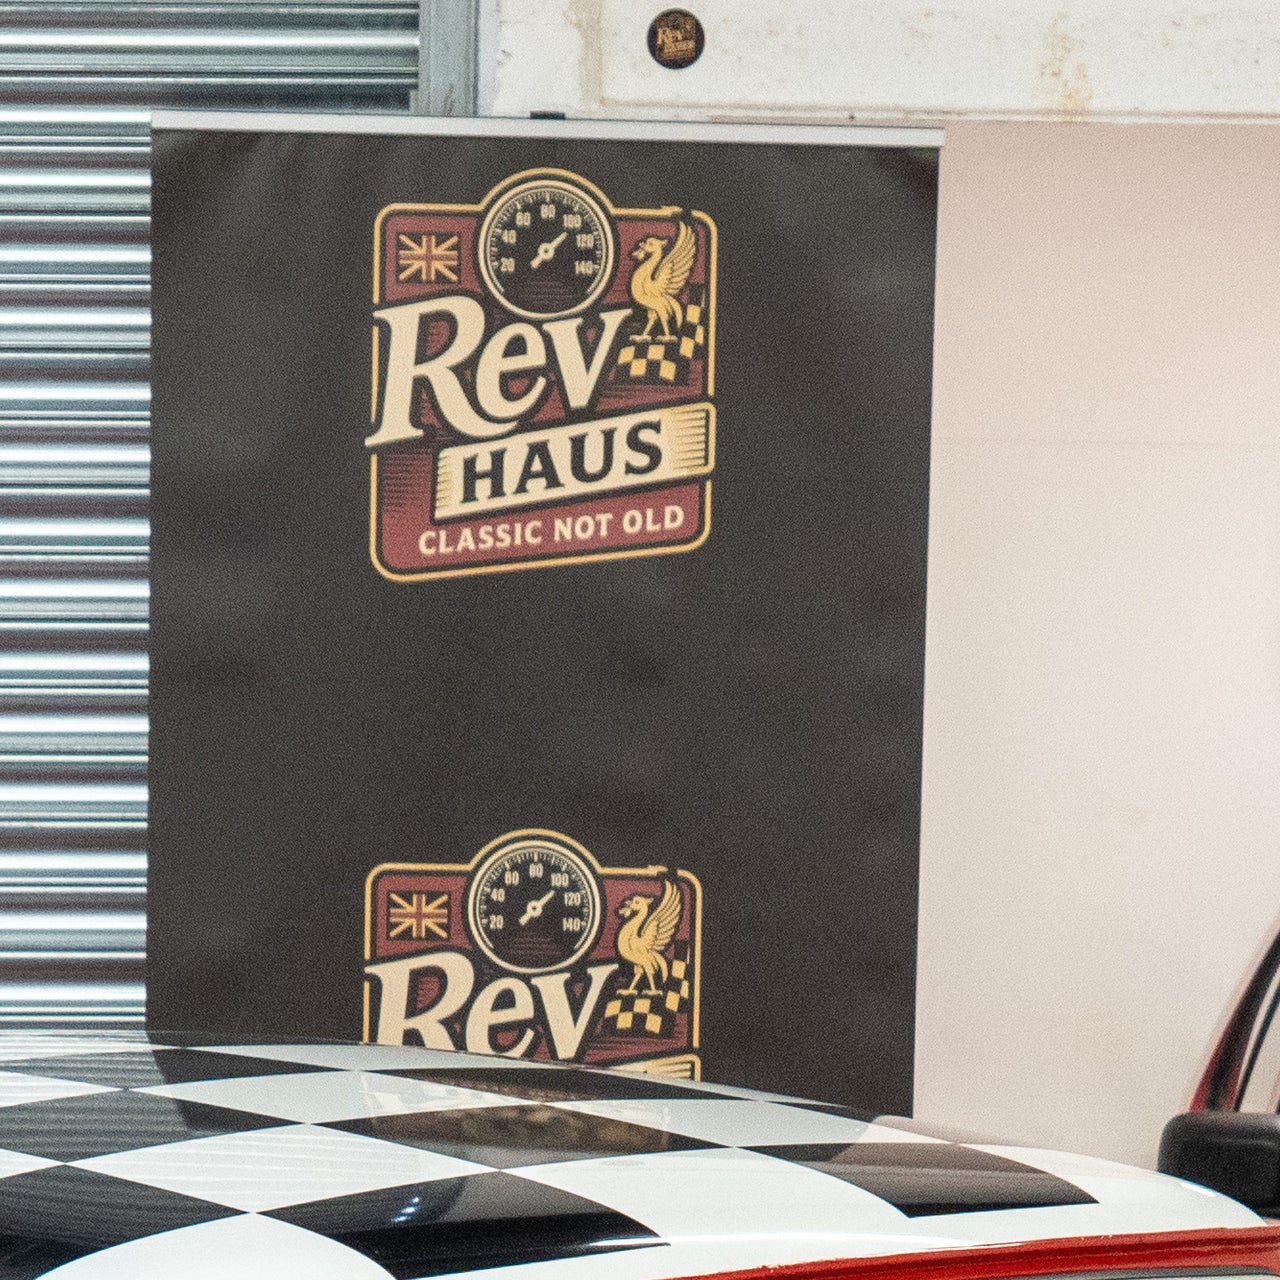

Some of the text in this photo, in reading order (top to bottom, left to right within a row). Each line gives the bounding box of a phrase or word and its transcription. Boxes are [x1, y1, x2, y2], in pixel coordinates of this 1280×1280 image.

[563, 213, 581, 228] 100
[502, 229, 517, 245] 40
[576, 233, 594, 248] 120
[500, 257, 515, 273] 20
[574, 260, 593, 275] 140
[365, 295, 632, 447] Rev
[460, 418, 663, 504] HAUS
[419, 505, 685, 555] CLASSIC NOT OLD
[529, 863, 544, 878] 80
[551, 873, 569, 888] 100
[491, 889, 506, 904] 40
[563, 892, 581, 906] 120
[489, 916, 504, 930] 20
[562, 918, 581, 932] 140
[364, 951, 620, 1060] Rev
